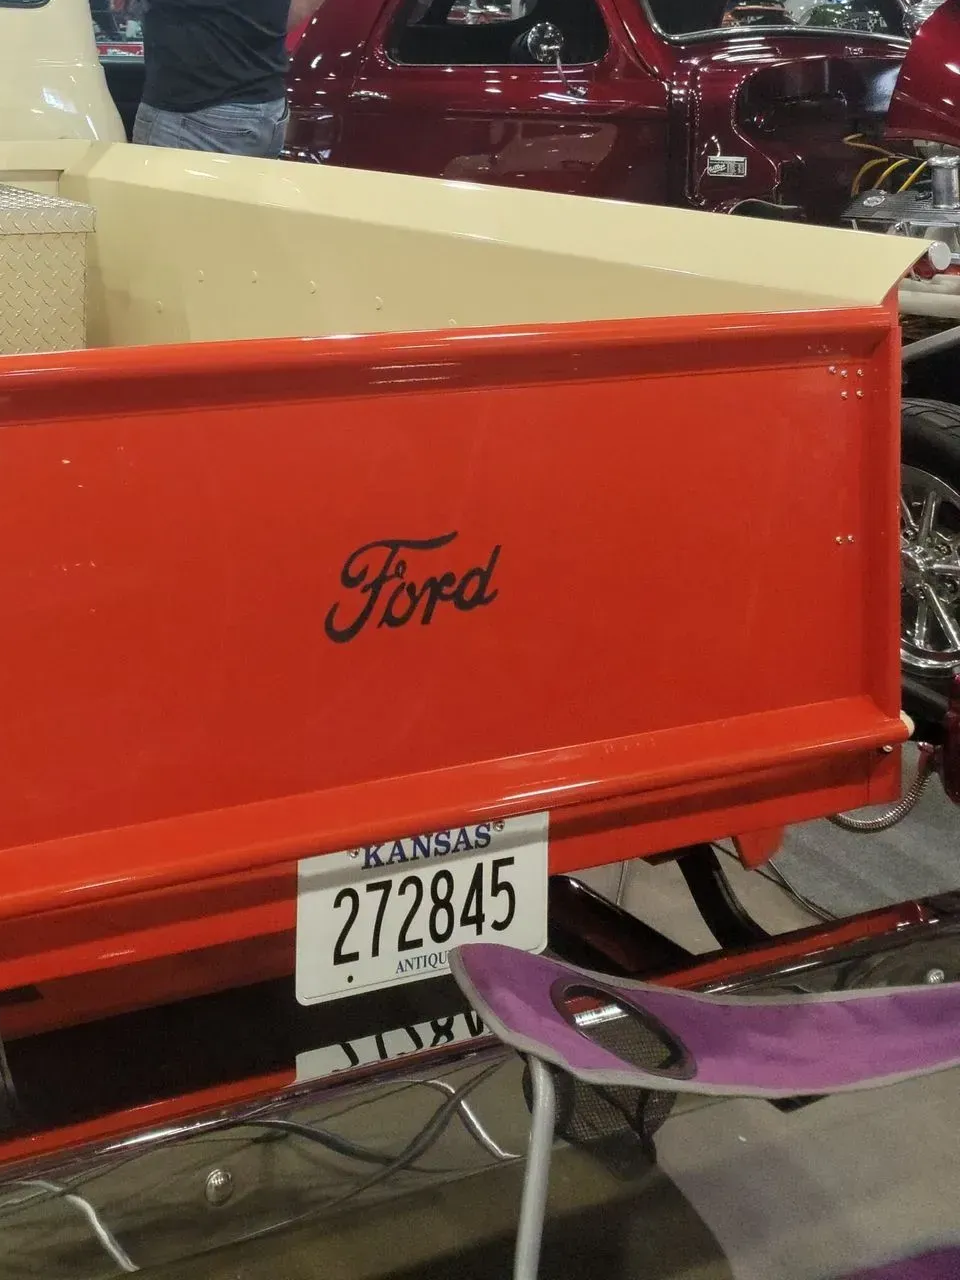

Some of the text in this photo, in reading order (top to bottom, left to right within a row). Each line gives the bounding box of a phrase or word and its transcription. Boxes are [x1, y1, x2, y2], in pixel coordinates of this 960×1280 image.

[324, 530, 502, 644] Ford
[360, 822, 491, 870] KANSAS
[333, 856, 516, 966] 272845
[395, 949, 451, 974] ANTIQU
